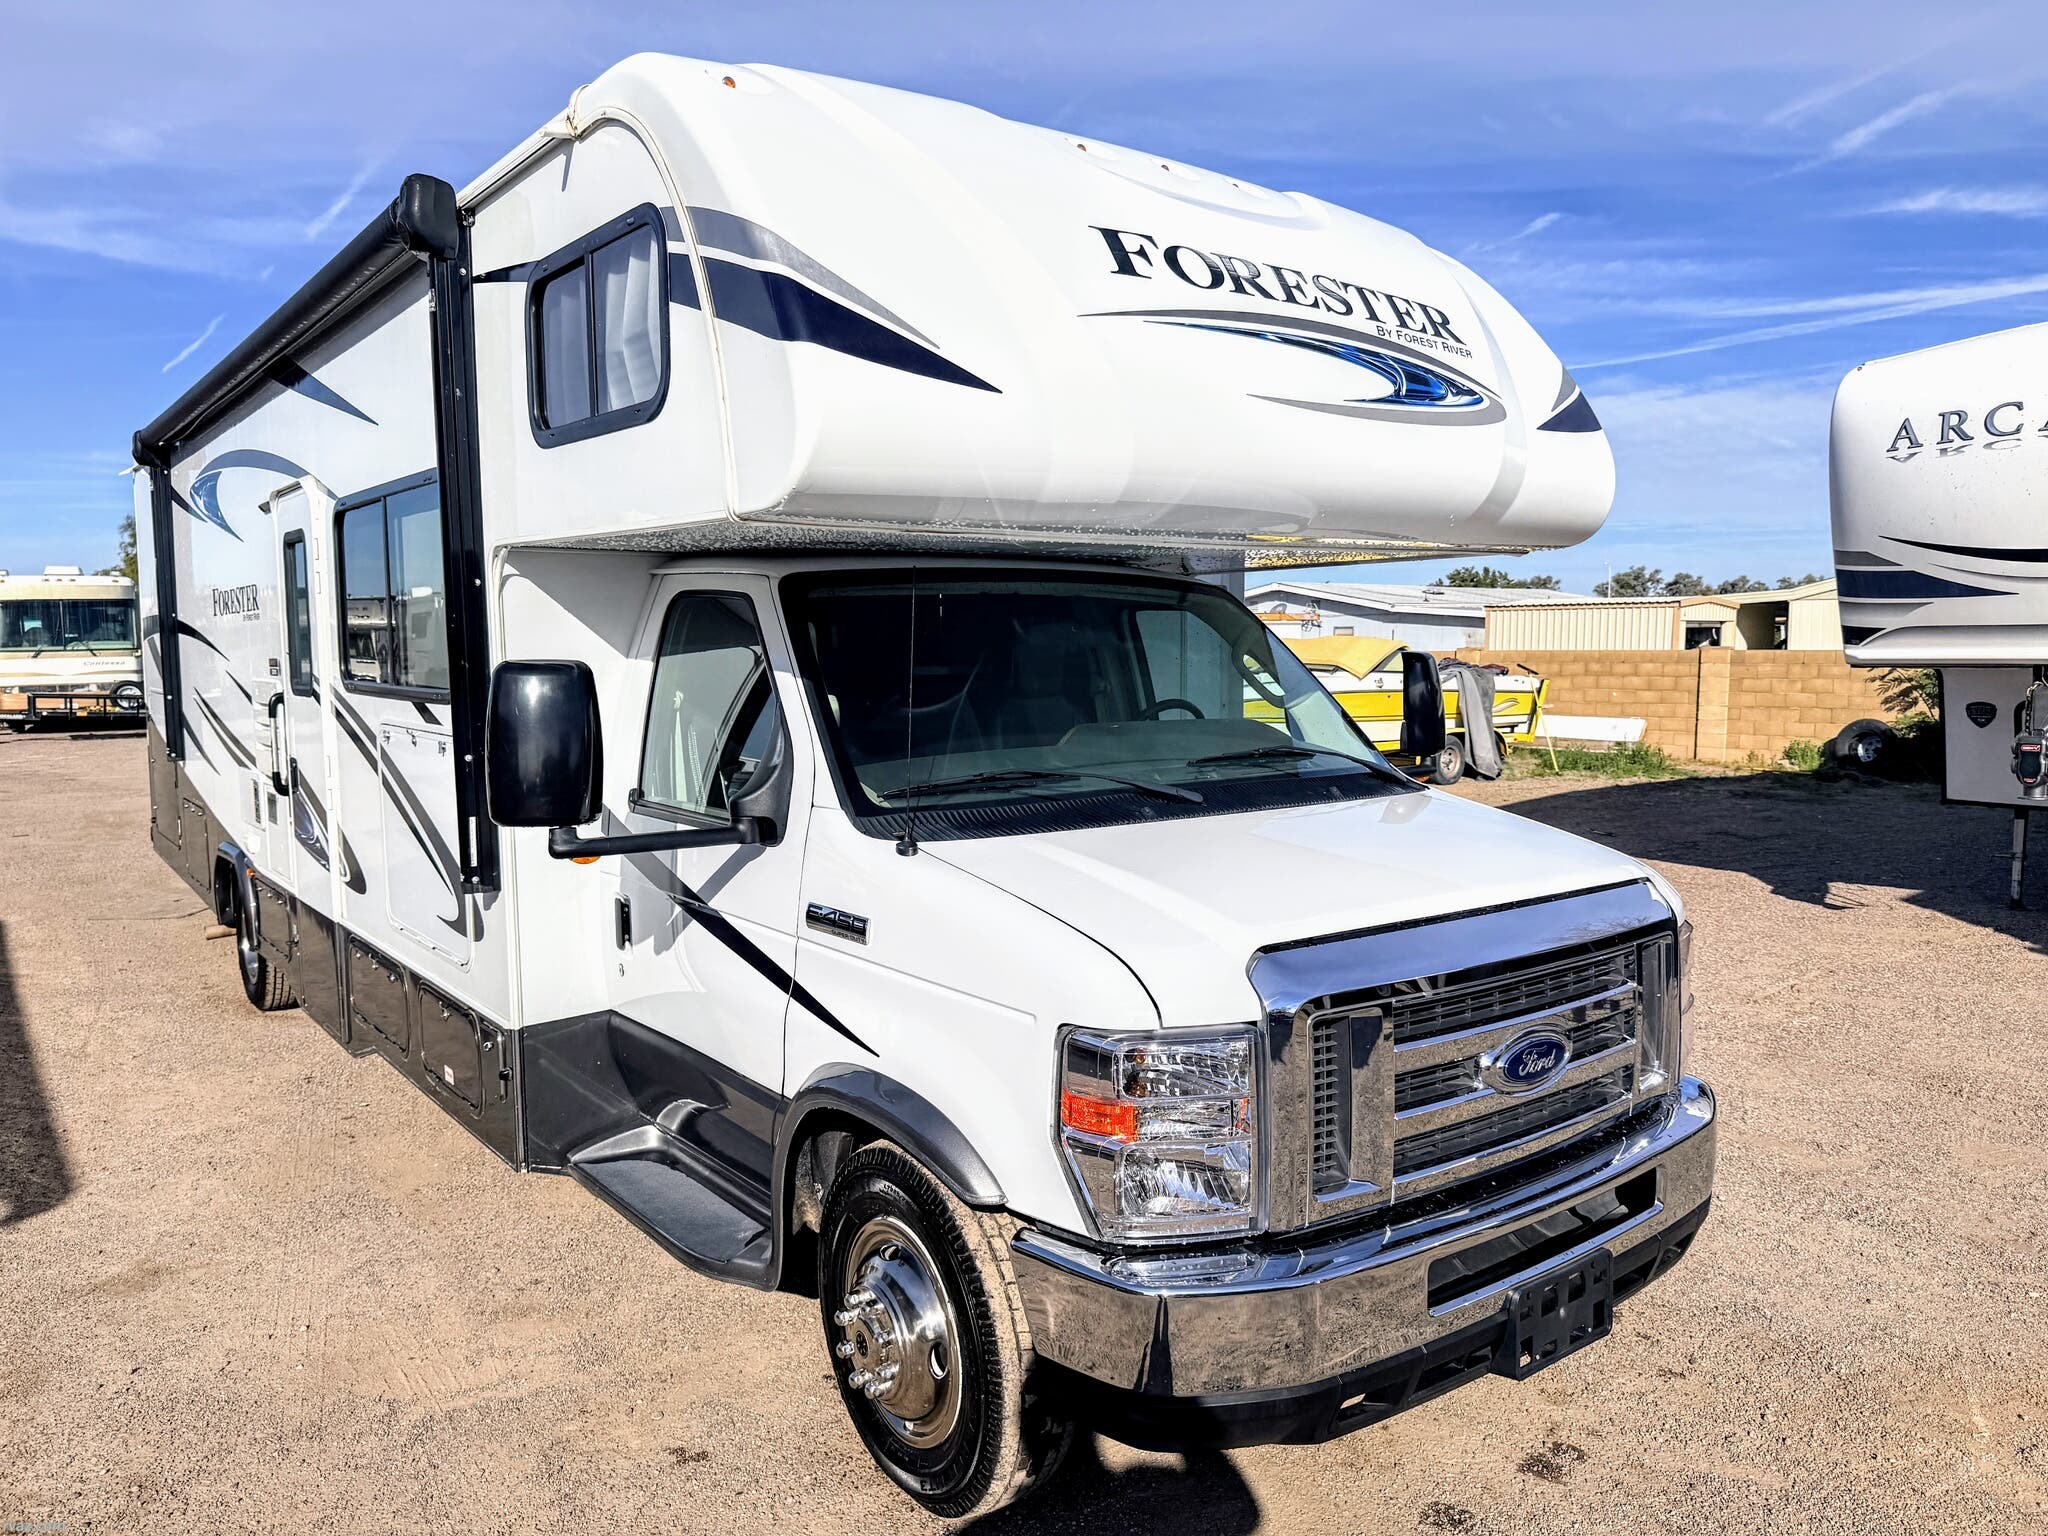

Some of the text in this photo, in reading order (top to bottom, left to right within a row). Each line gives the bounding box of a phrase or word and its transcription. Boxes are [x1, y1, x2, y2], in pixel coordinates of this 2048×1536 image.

[1088, 225, 1467, 345] FORESTER
[1376, 325, 1473, 359] BY FOREST RIVER
[1886, 401, 2048, 453] ARC
[212, 584, 259, 616] FORESTER
[1519, 1045, 1556, 1076] Ford
